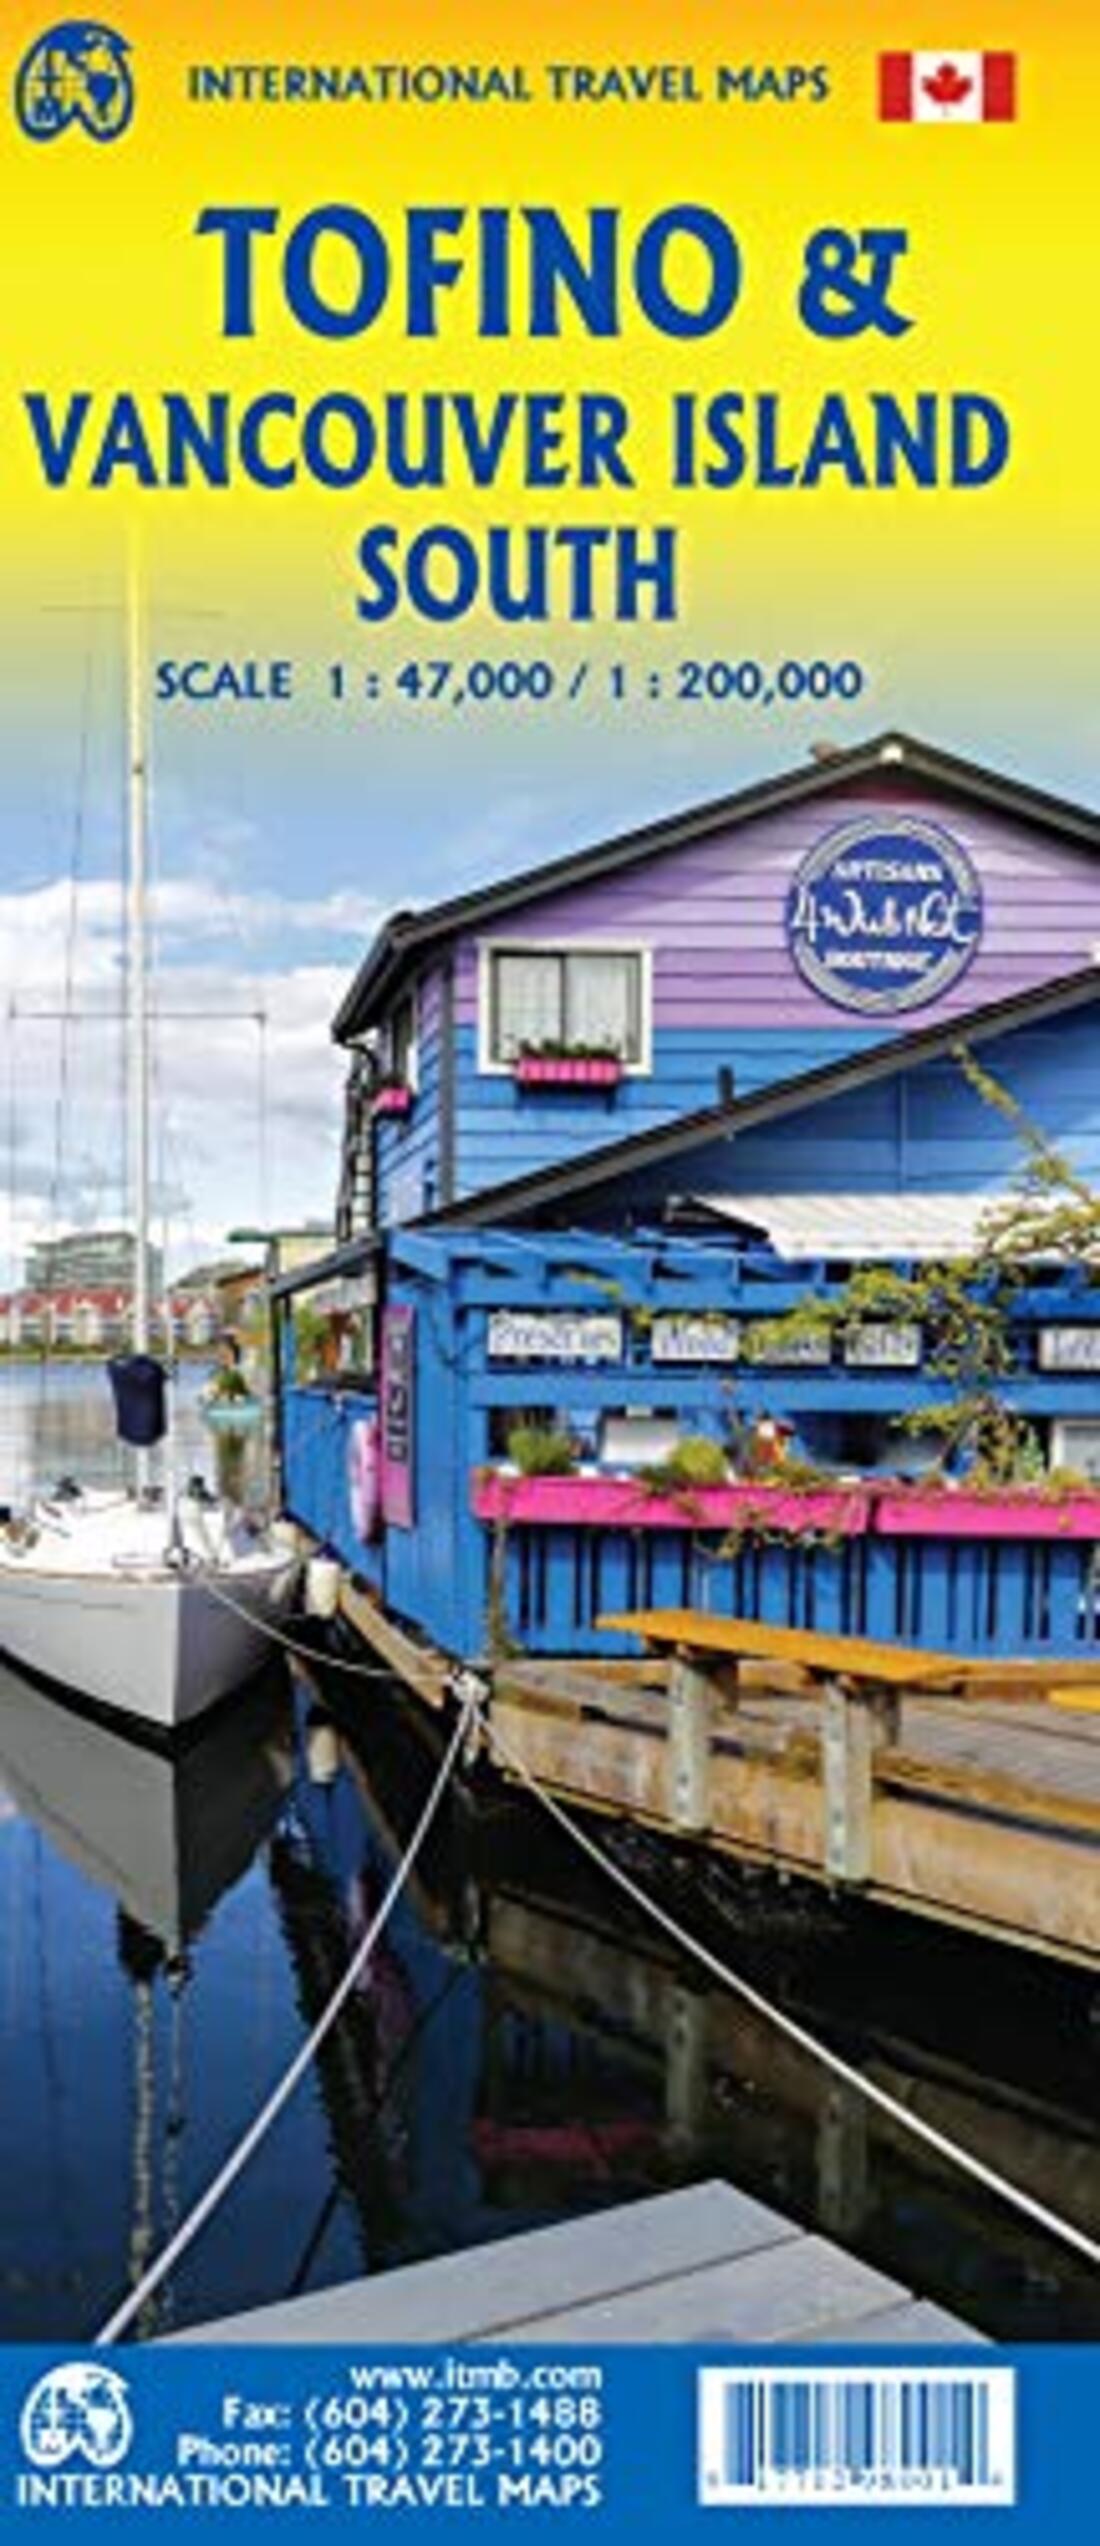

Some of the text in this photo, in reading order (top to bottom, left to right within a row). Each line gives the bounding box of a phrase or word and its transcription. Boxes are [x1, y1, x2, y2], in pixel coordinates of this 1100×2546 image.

[190, 66, 829, 101] INTERNATIONAL TRAVEL MAPS
[196, 204, 913, 339] TOFINO &
[25, 392, 1009, 489] VANCOUVER ISLAND
[357, 525, 677, 622] SOUTH
[156, 661, 292, 700] SCALE
[397, 661, 553, 706] 47,000
[677, 661, 863, 706] 200,000
[350, 2359, 602, 2389] www.itmb.com
[222, 2396, 602, 2436] Fax: (604) 273-1488
[177, 2433, 602, 2473] Phone: (604) 273-1400
[17, 2474, 602, 2506] INTERNATIONAL TRAVEL MAPS
